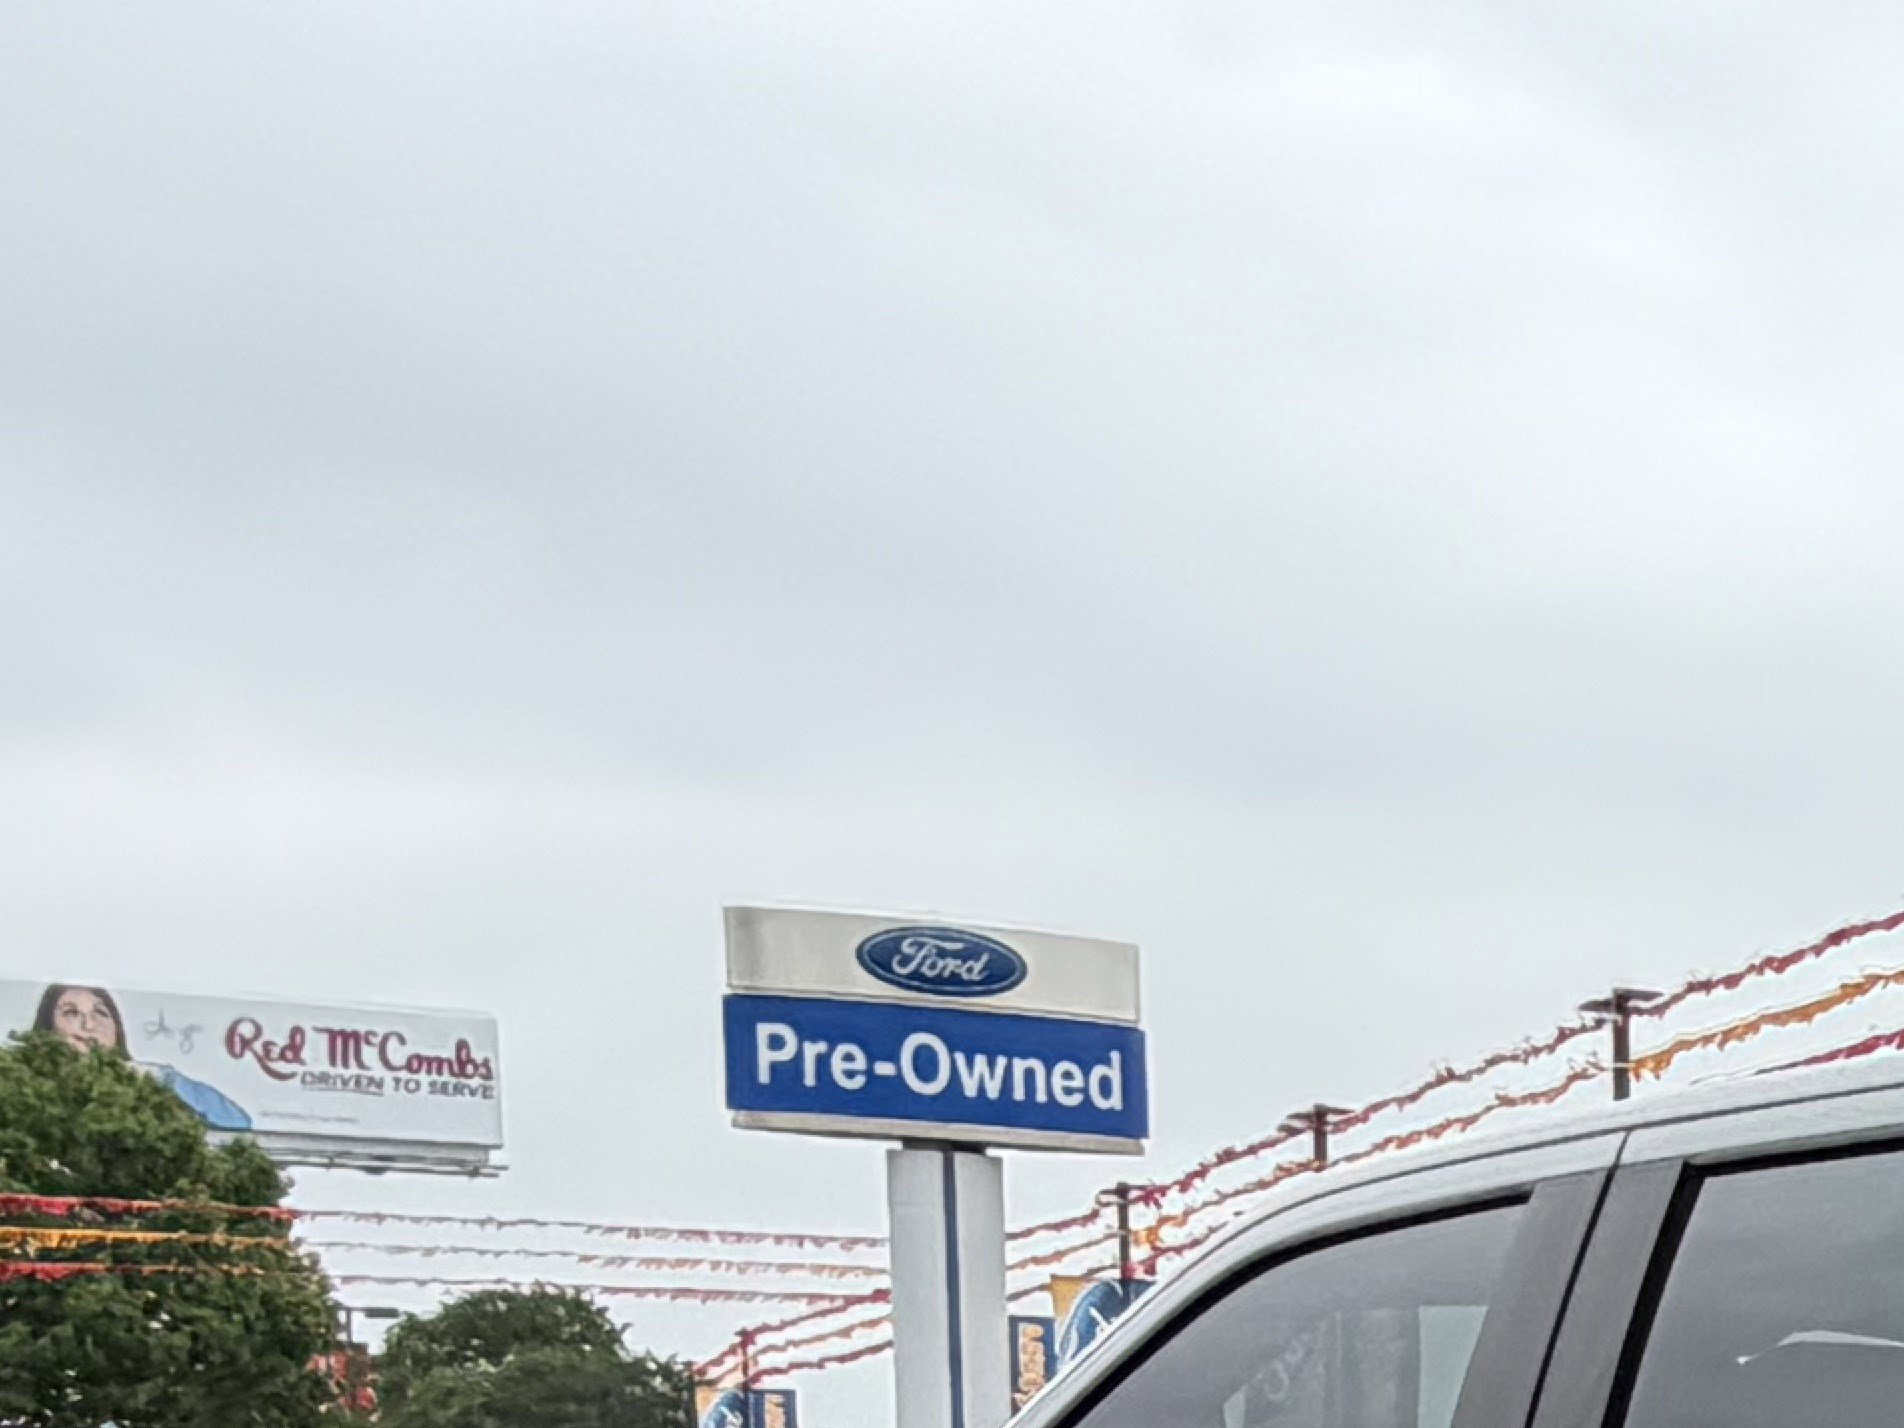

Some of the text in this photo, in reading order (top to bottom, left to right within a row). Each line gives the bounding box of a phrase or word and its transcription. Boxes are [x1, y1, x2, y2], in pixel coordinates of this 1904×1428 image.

[891, 936, 991, 982] Ford
[224, 1016, 306, 1082] Red
[311, 1024, 495, 1082] McCombs
[755, 1021, 1123, 1112] Pre-Owned
[300, 1070, 496, 1100] DRIVEN TO SERVE
